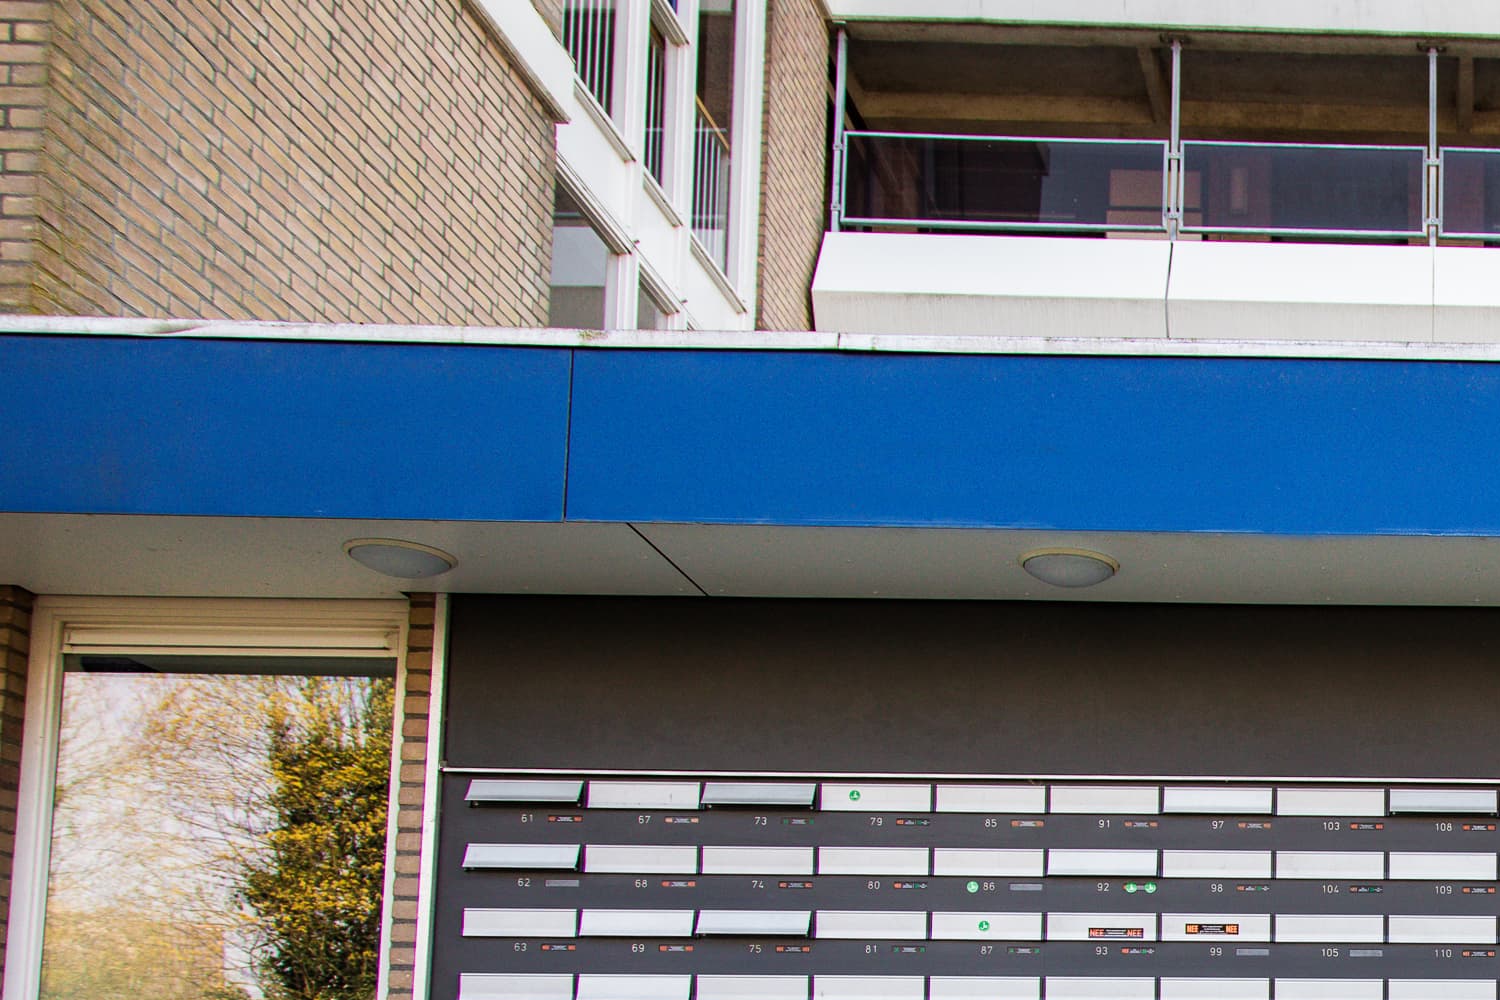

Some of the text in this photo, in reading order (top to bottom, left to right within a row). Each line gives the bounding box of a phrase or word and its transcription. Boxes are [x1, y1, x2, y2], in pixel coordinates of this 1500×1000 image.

[520, 813, 533, 823] 61
[638, 815, 652, 825] 67
[754, 816, 768, 826] 73
[870, 816, 883, 827] 79
[984, 818, 998, 828] 85
[1098, 819, 1110, 829] 91
[1211, 820, 1225, 830] 97
[1323, 821, 1340, 831] 103
[1435, 822, 1453, 832] 108
[517, 877, 531, 888] 62
[634, 879, 648, 889] 68
[751, 879, 764, 889] 74
[867, 880, 881, 890] 80
[982, 881, 996, 891] 86
[1096, 882, 1110, 892] 92
[1210, 883, 1224, 893] 98
[1322, 884, 1340, 894] 104
[1435, 885, 1453, 895] 109
[1089, 929, 1104, 937] NEE
[1126, 929, 1142, 937] NEE
[1186, 925, 1198, 933] NEE
[1225, 925, 1238, 933] NEE
[513, 942, 528, 952] 63
[631, 943, 645, 953] 69
[748, 944, 762, 954] 75
[865, 944, 877, 954] 81
[980, 945, 993, 955] 87
[1095, 945, 1108, 956] 93
[1209, 946, 1223, 957] 99
[1321, 947, 1339, 958] 105
[1434, 948, 1452, 958] 110
